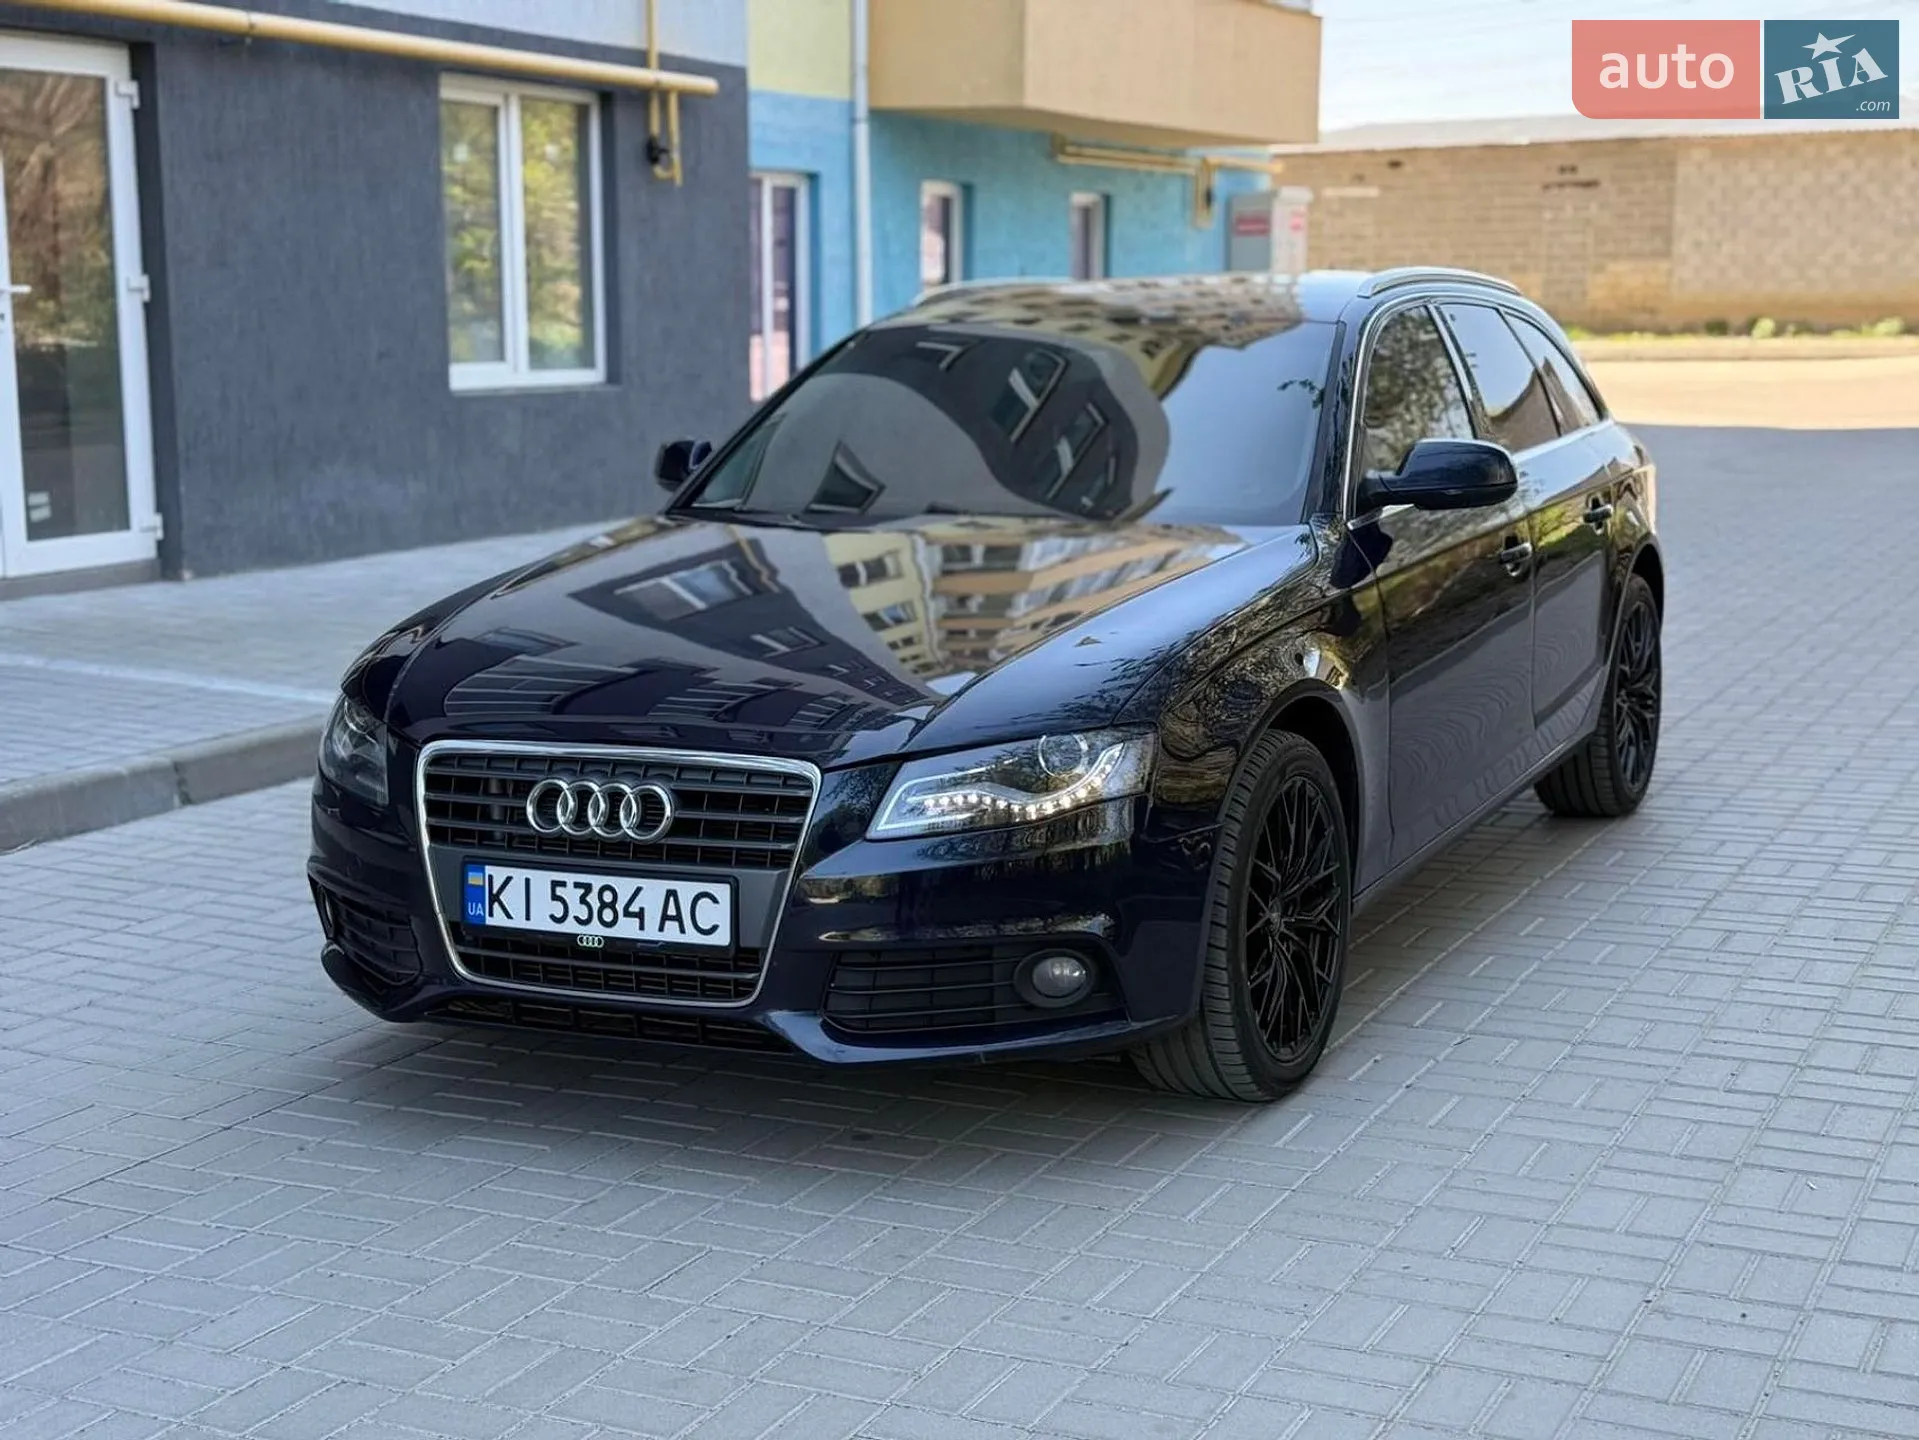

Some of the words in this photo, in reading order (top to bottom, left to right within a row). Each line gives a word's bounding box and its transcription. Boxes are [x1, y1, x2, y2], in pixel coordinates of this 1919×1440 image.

[468, 902, 484, 916] UA
[487, 874, 531, 921] KI
[549, 879, 646, 931] 5384
[658, 889, 720, 936] AC
